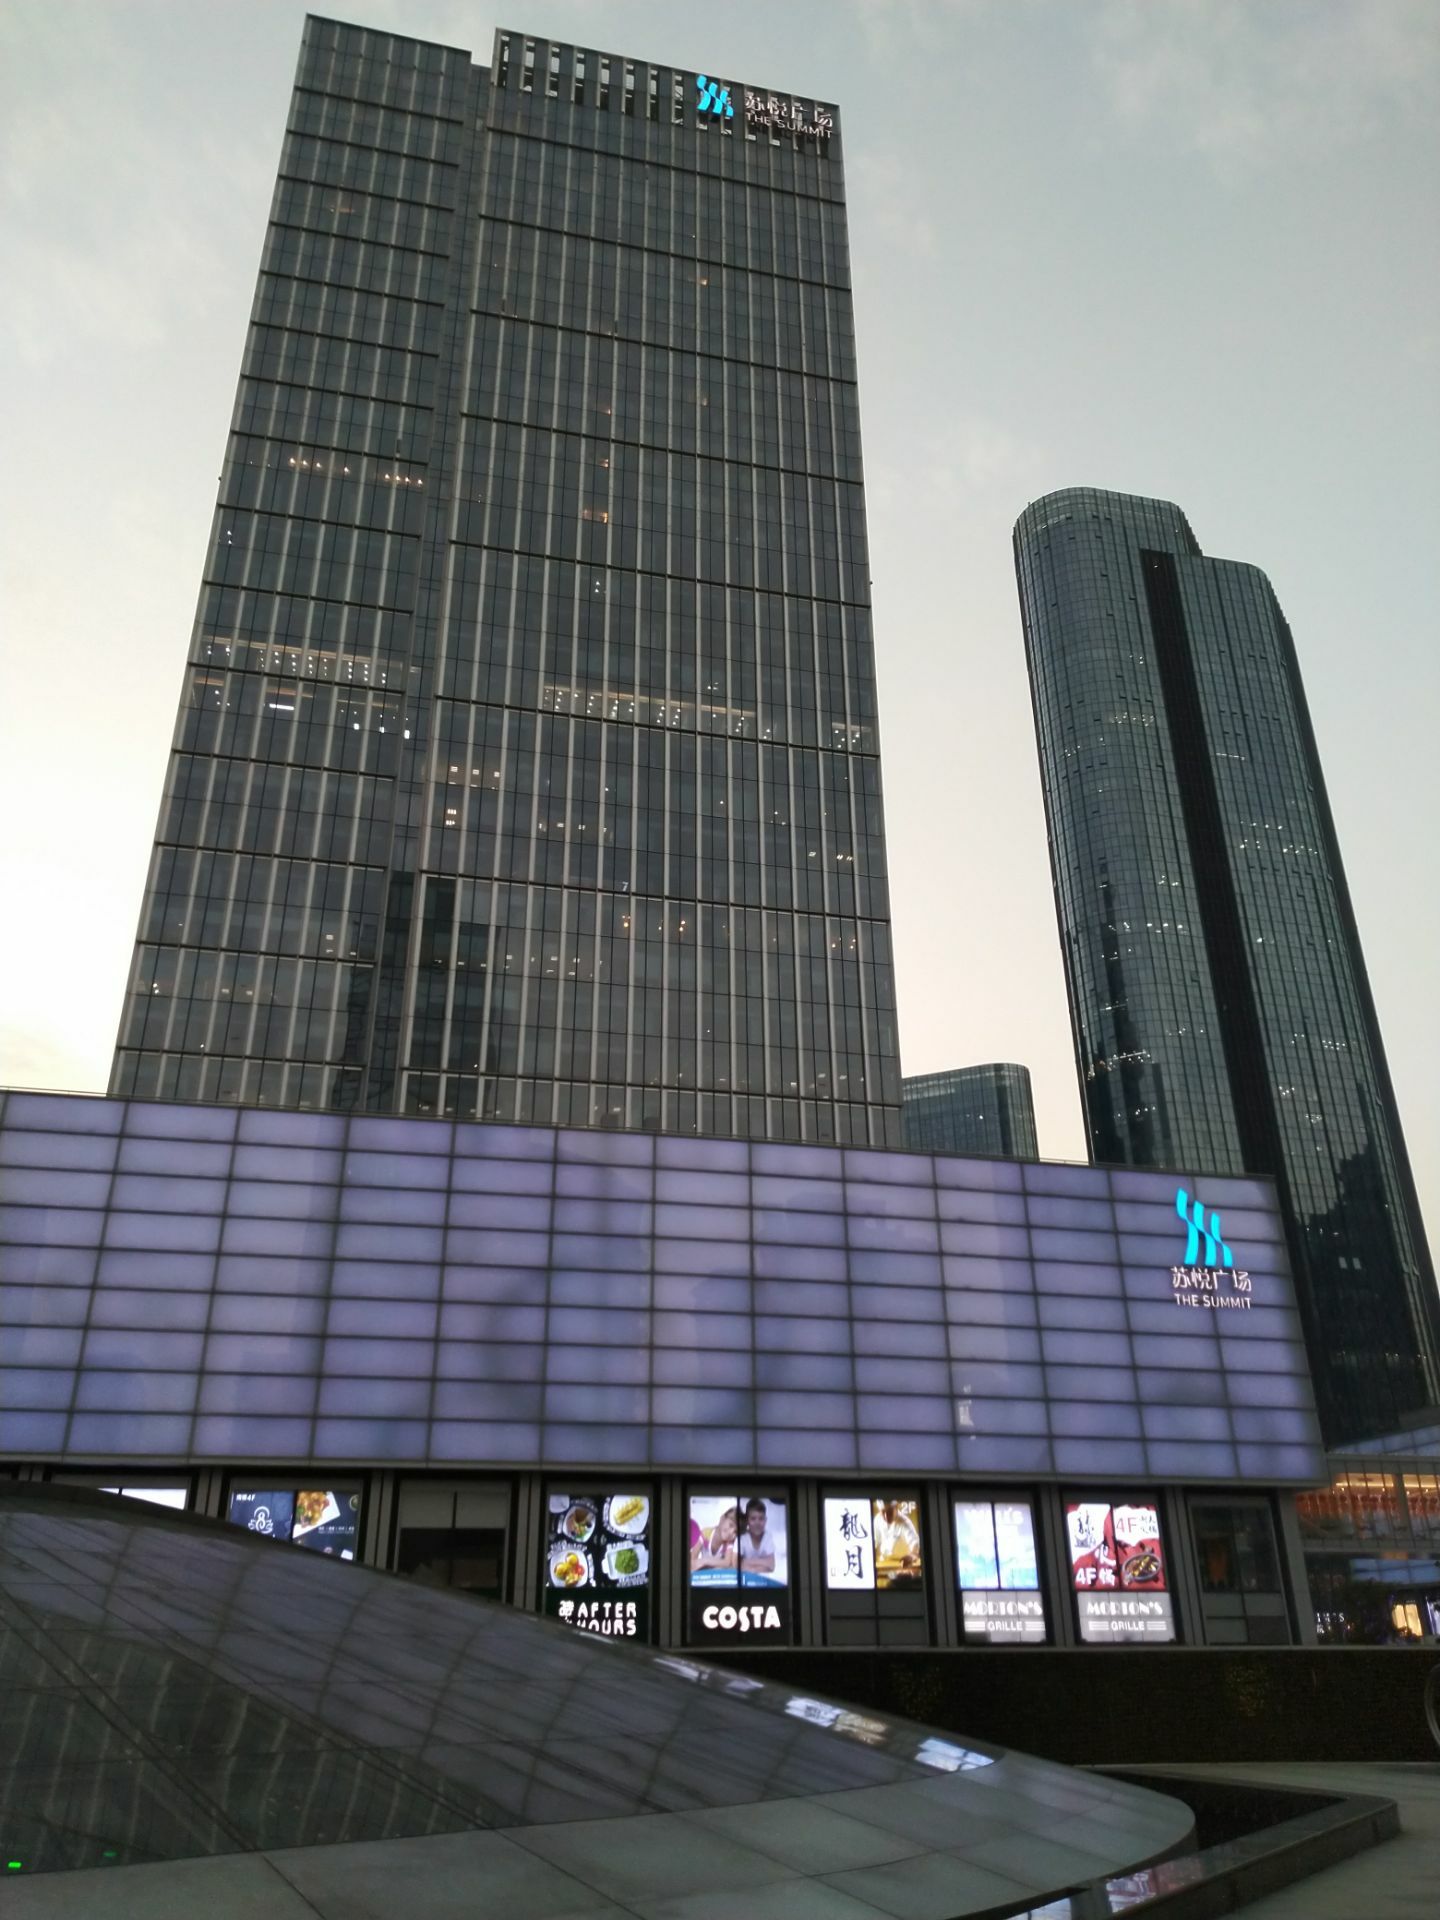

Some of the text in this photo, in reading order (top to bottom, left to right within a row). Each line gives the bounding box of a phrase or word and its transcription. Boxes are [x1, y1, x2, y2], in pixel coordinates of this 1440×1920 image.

[745, 112, 833, 139] THE SUMMIT
[1170, 1266, 1252, 1292] 苏悦广场
[1173, 1293, 1252, 1309] THE SUMMIT
[1116, 1516, 1137, 1534] 4F
[1075, 1567, 1097, 1585] 4F
[577, 1601, 637, 1618] AFTER
[964, 1600, 1043, 1616] MORTON'S
[1087, 1600, 1163, 1615] MORTON'S
[702, 1605, 781, 1632] COSTA
[987, 1620, 1024, 1632] GRILLE
[1110, 1620, 1146, 1631] GRILLE
